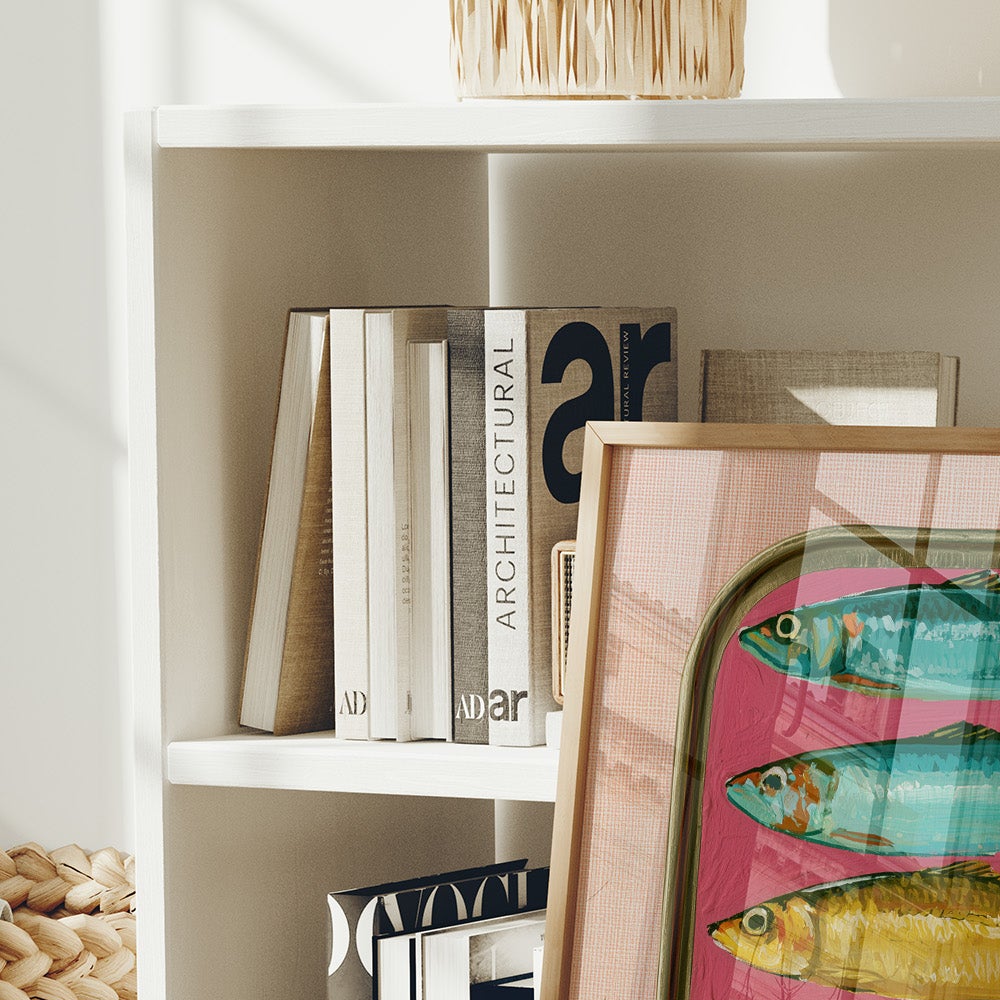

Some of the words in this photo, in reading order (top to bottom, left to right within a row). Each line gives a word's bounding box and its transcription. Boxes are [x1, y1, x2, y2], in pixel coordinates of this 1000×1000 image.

[541, 321, 671, 504] ar
[493, 338, 516, 630] ARCHITECTURAL
[339, 690, 367, 715] AD
[455, 693, 485, 721] AD
[489, 688, 529, 722] ar
